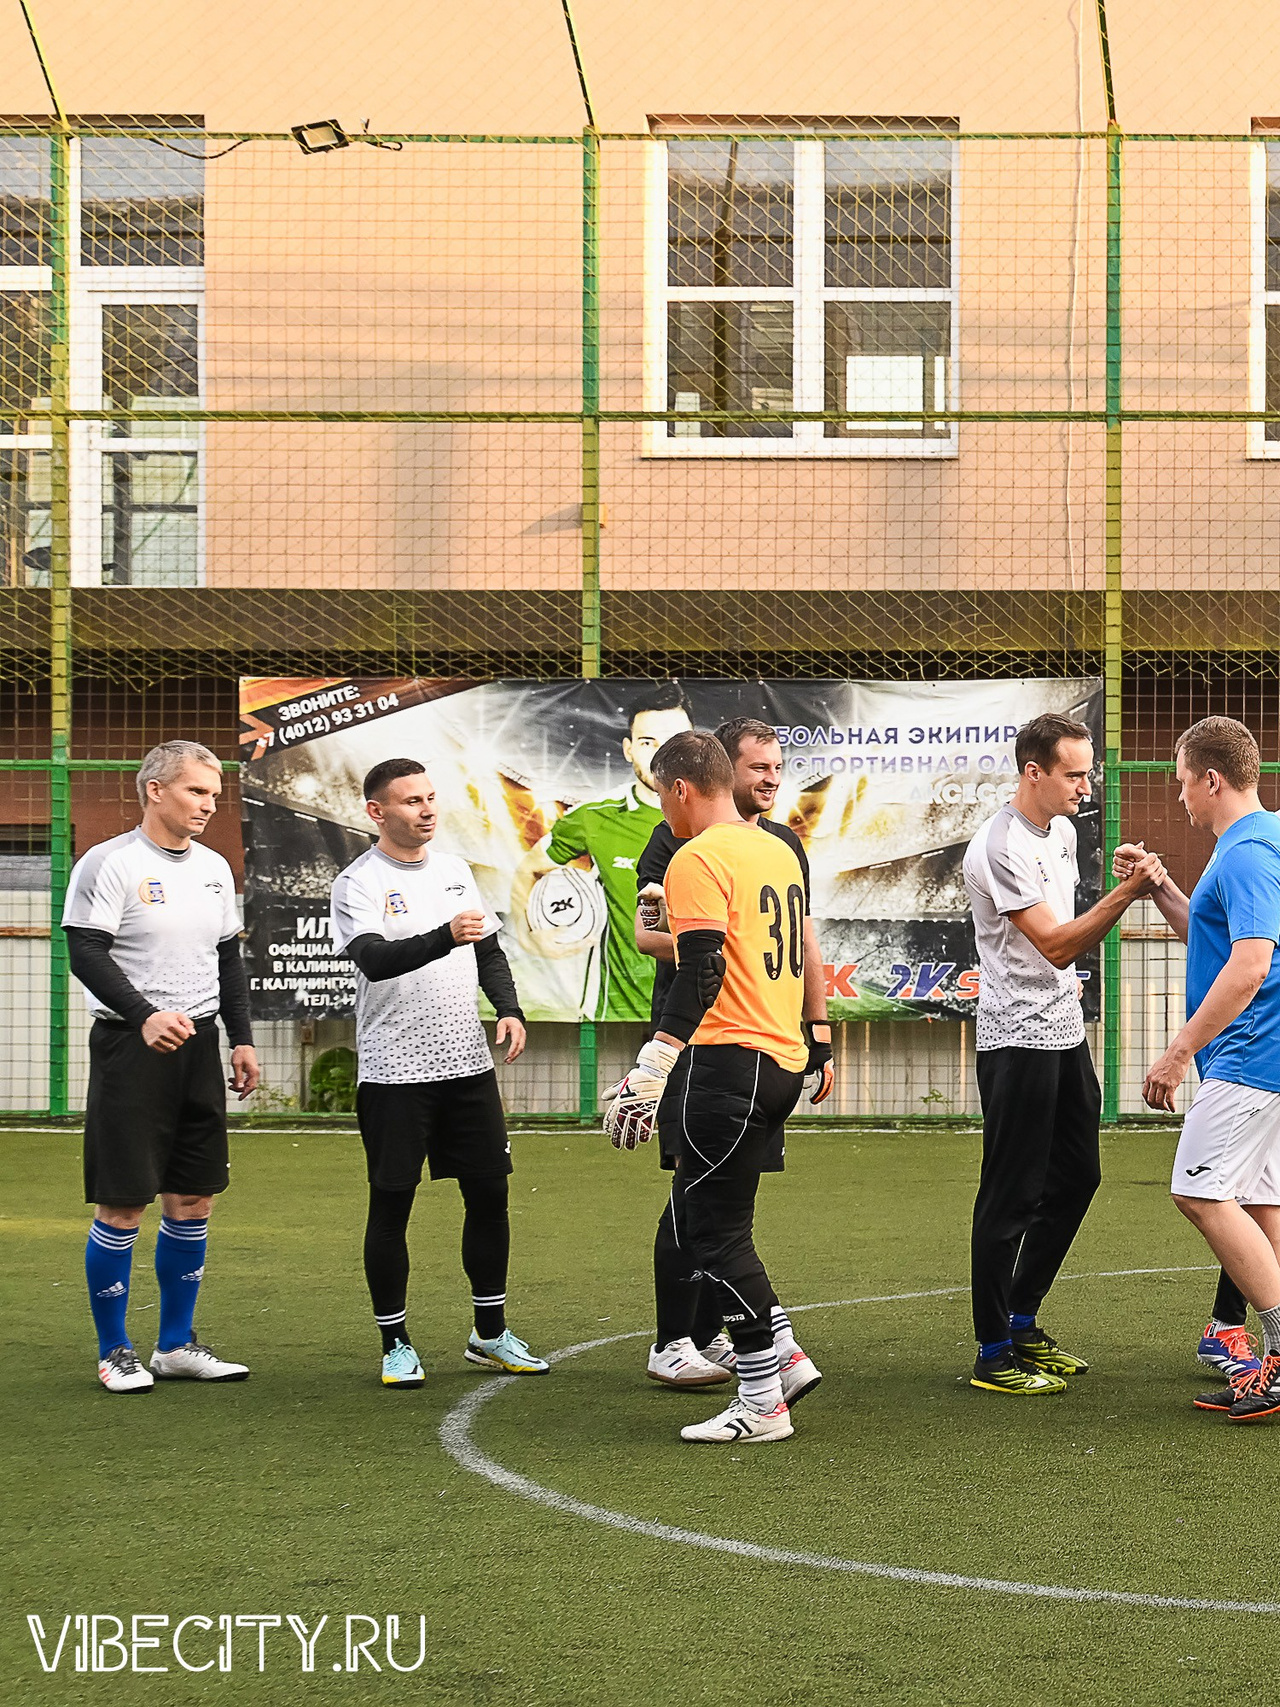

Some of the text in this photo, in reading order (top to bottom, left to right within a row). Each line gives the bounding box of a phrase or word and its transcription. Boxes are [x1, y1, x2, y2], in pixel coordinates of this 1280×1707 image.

[277, 685, 361, 721] ЗВОНИТЕ:
[256, 692, 399, 748] +7 (4012) 93 31 04
[776, 725, 1017, 745] БОЛЬНАЯ ЭКИПИР
[789, 755, 1014, 775] СПОРТИВНАЯ ОД
[910, 783, 1018, 804] АКСЕСС
[612, 856, 636, 870] 2K
[550, 897, 574, 914] 2K
[297, 917, 333, 938] ИЛ
[760, 885, 804, 980] 30
[268, 943, 335, 958] ОФИЦИА
[273, 961, 355, 973] В КАЛИНИН
[250, 978, 357, 990] Г. КАЛИНИНГРА
